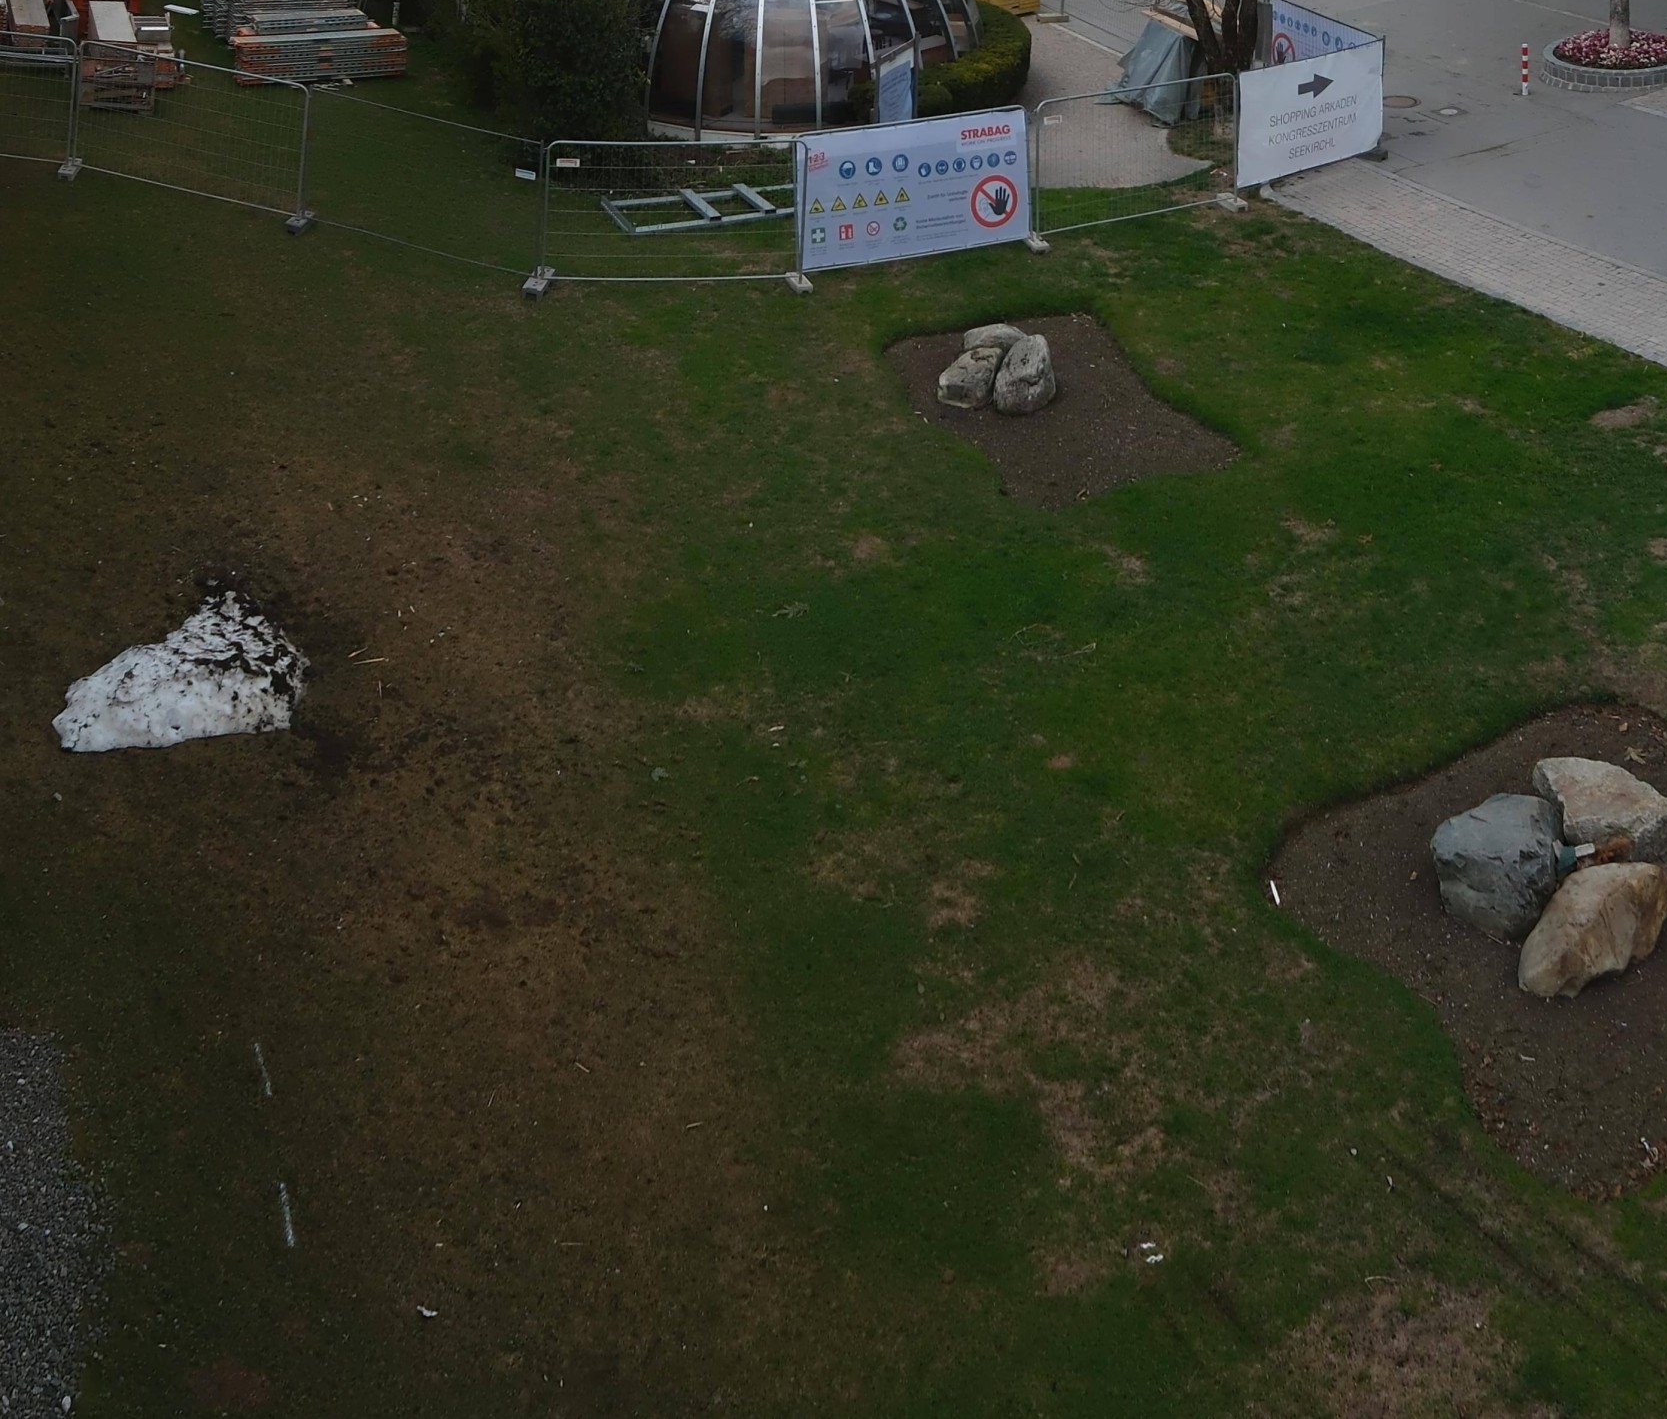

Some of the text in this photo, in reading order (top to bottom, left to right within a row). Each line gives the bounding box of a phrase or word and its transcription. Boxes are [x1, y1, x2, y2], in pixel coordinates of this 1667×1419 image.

[1269, 94, 1358, 128] SHOPPING ARKADEN
[960, 124, 1011, 140] STRABAG
[1268, 113, 1357, 147] KONGRESSZENTRUM
[1288, 137, 1336, 160] SEEKIRCHL
